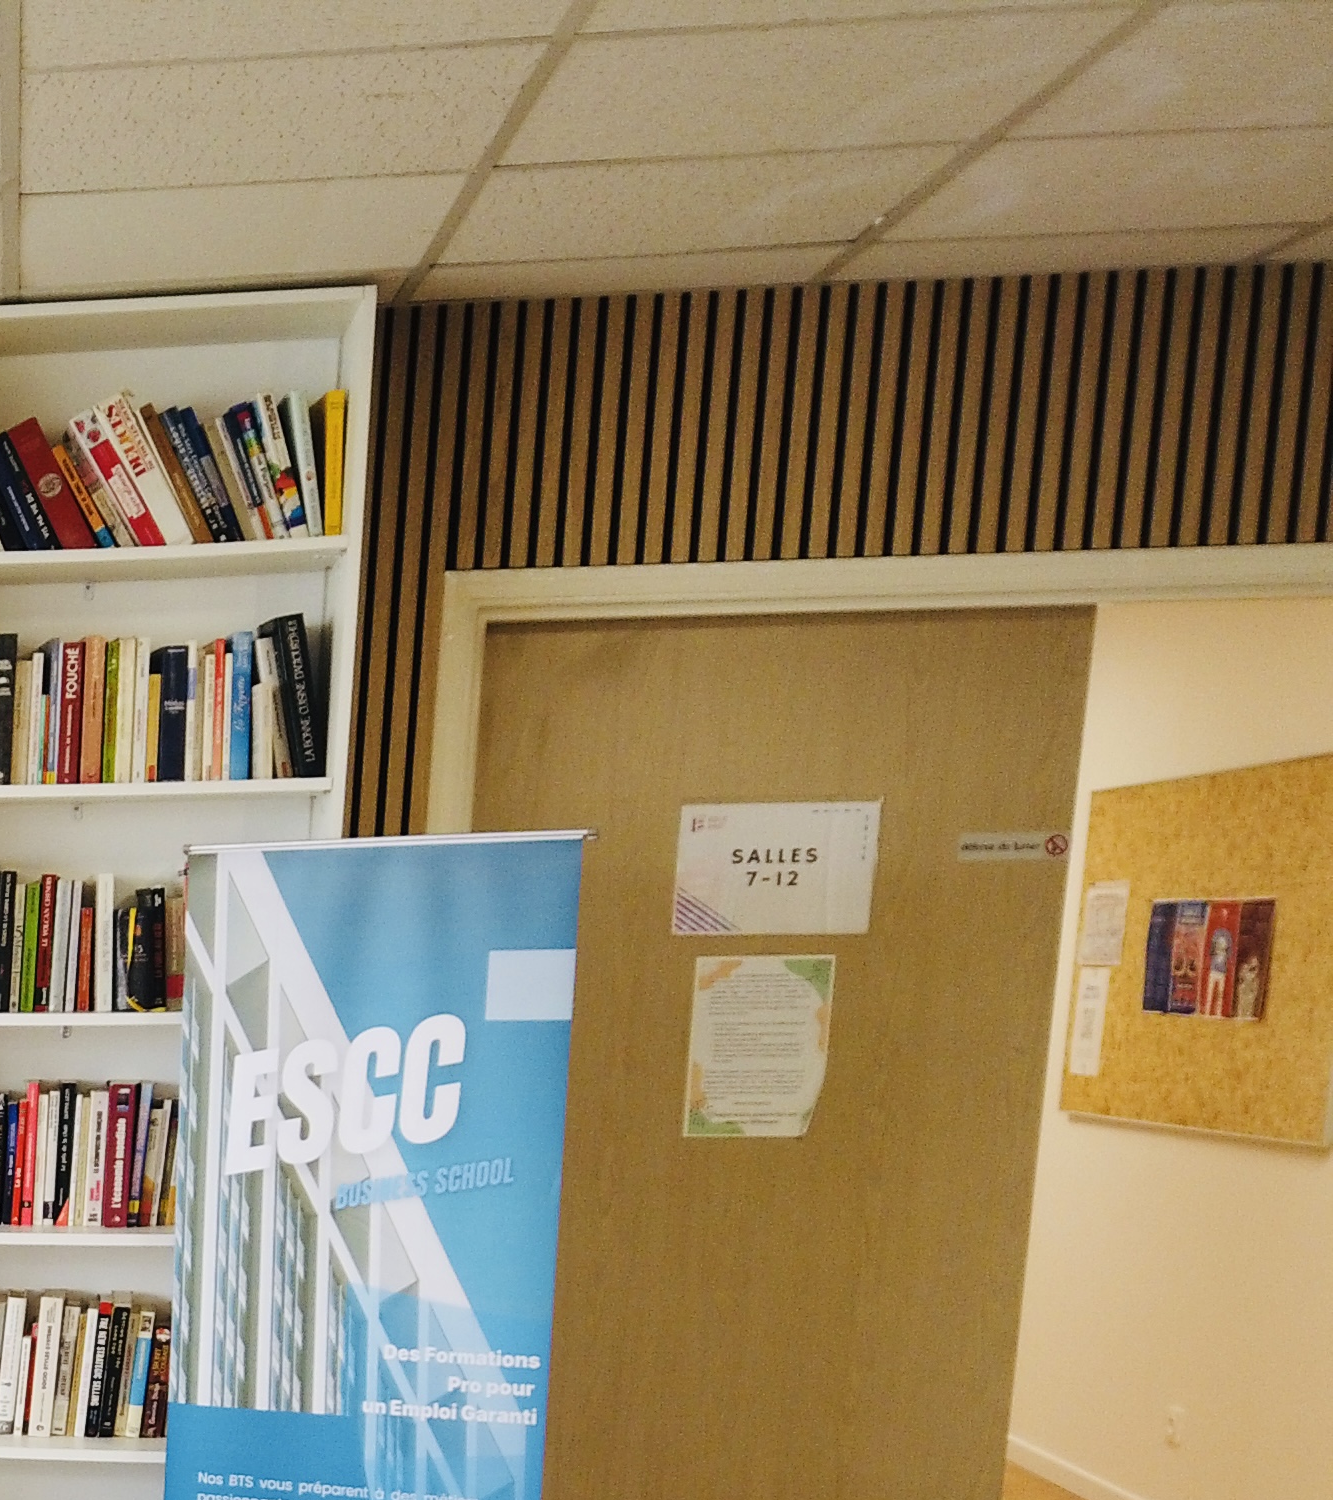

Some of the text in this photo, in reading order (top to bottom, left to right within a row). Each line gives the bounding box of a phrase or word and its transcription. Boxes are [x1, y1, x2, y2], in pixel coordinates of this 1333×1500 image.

[65, 648, 79, 699] FOUCHÉ
[732, 848, 819, 864] SALLES
[224, 1013, 467, 1175] ESCC
[434, 1157, 514, 1194] SCHOOL
[383, 1343, 540, 1369] Des Formations
[448, 1376, 535, 1398] Pro pour
[362, 1399, 537, 1426] un Emploi Garanti
[198, 1472, 223, 1485] Nos
[228, 1474, 253, 1488] BTS
[259, 1479, 292, 1491] vous
[298, 1480, 368, 1499] préparent
[375, 1486, 384, 1499] à
